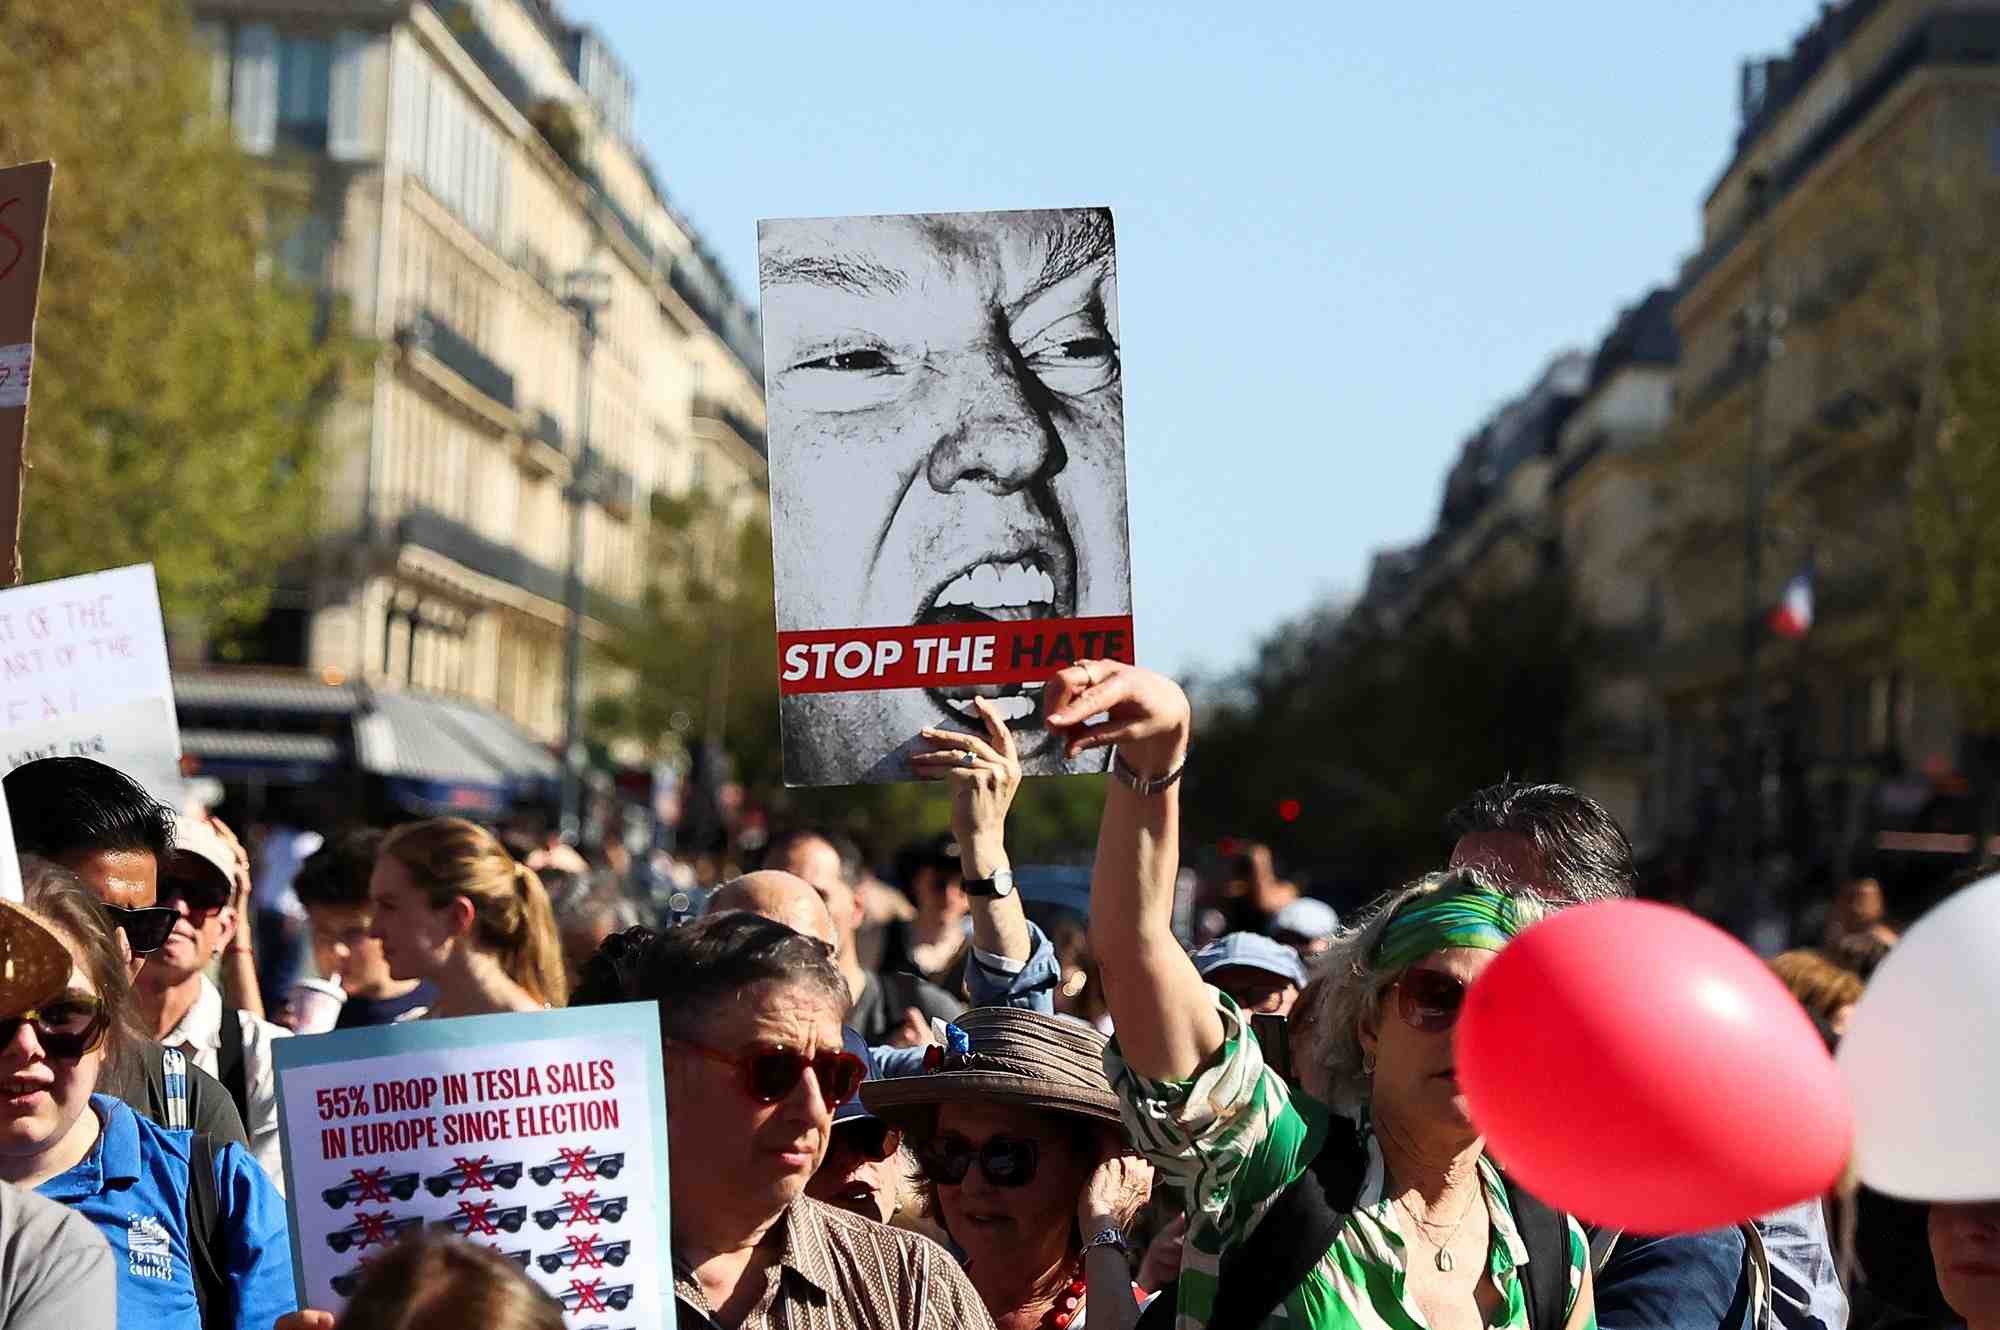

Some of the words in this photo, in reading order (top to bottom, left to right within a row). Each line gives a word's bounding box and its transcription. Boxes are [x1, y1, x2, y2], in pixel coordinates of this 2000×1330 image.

[782, 640, 903, 681] STOP
[912, 635, 997, 674] THE
[1010, 629, 1125, 668] HATE
[315, 1084, 370, 1121] 55%
[372, 1077, 437, 1114] DROP
[443, 1074, 469, 1106] IN
[472, 1066, 542, 1102] TESLA
[546, 1060, 616, 1095] SALES
[320, 1128, 346, 1160] IN
[352, 1114, 439, 1155] EUROPE
[443, 1108, 511, 1146] SINCE
[517, 1099, 620, 1137] ELECTION
[128, 1250, 172, 1269] SPIRIT
[129, 1264, 173, 1281] CRUISES
